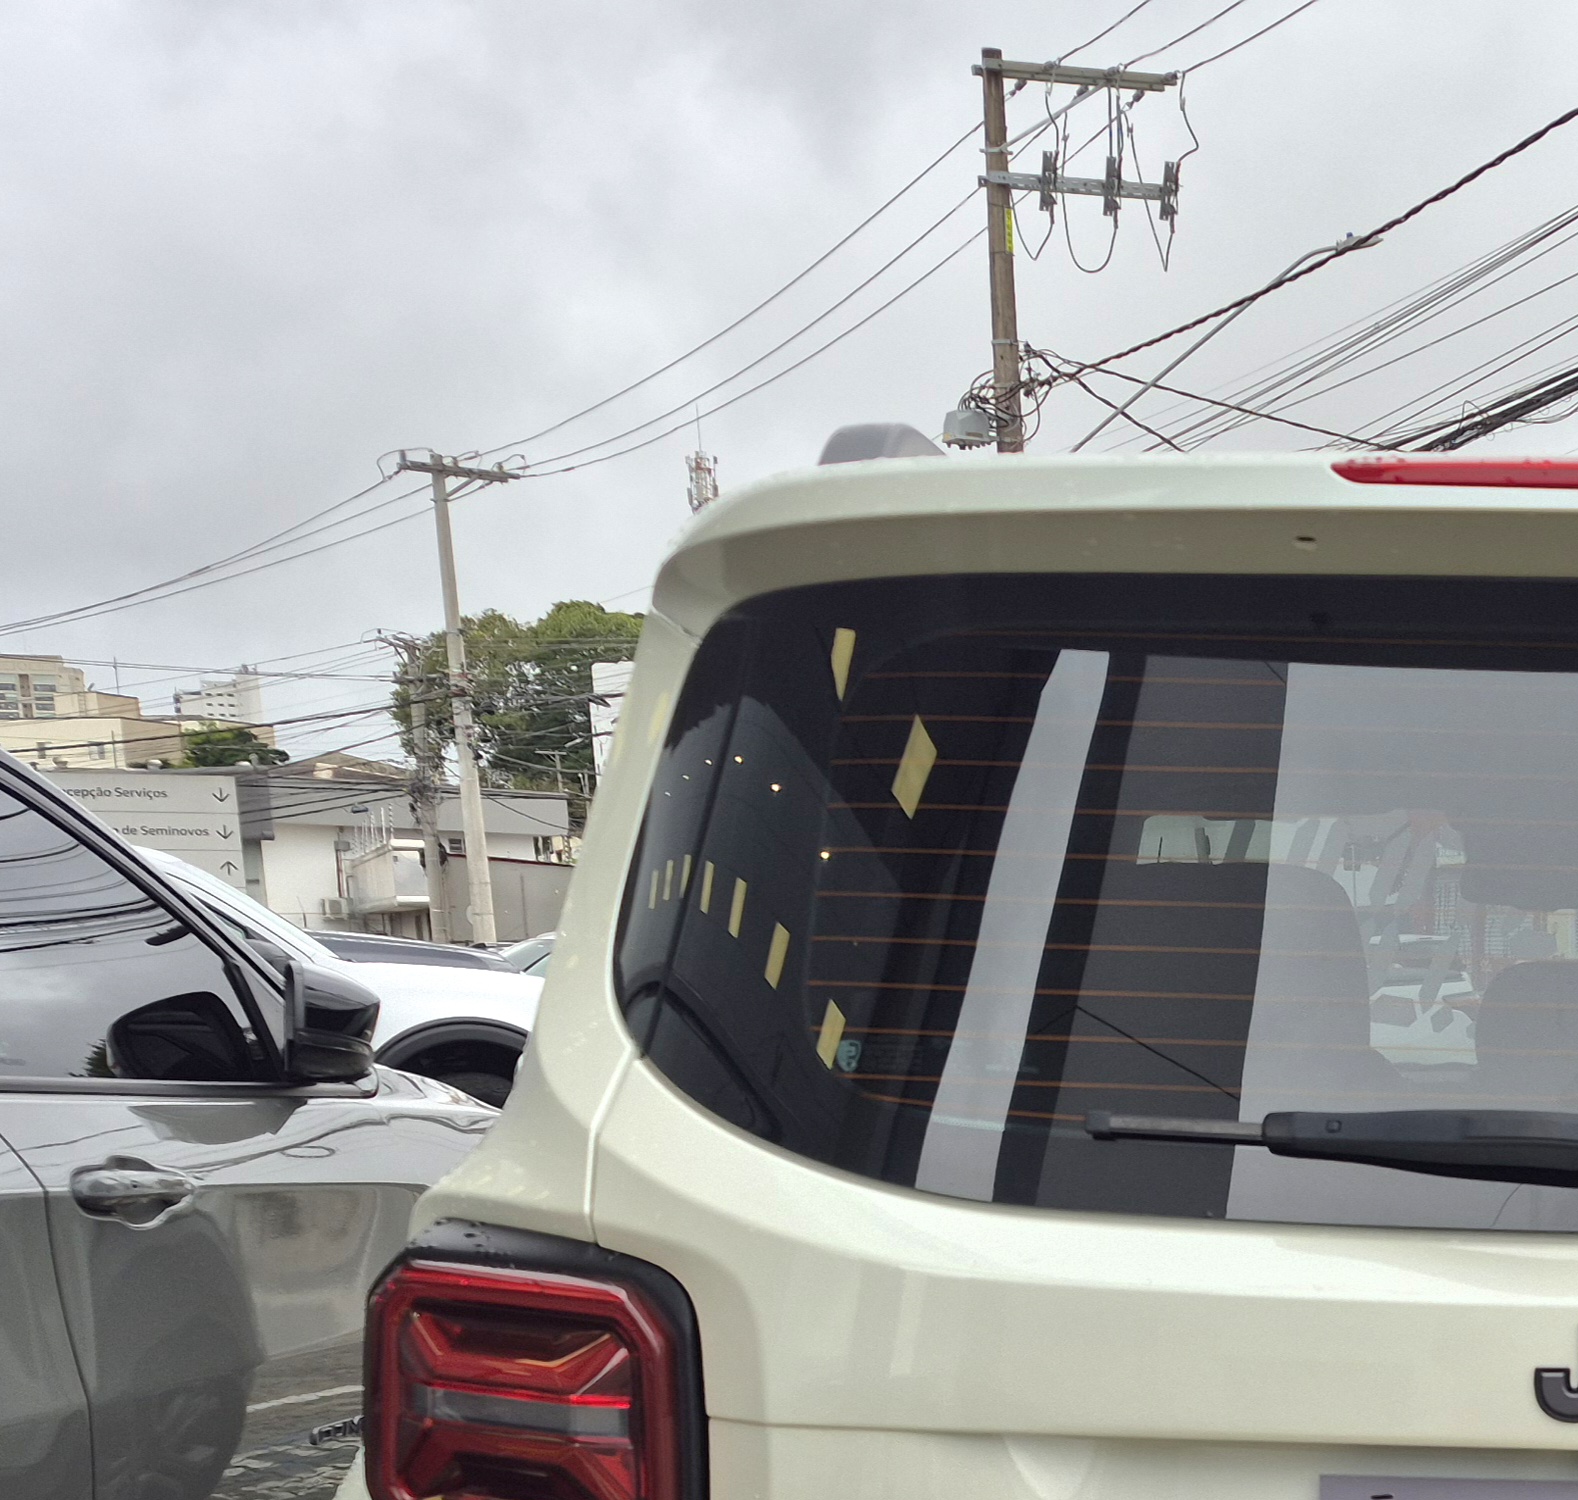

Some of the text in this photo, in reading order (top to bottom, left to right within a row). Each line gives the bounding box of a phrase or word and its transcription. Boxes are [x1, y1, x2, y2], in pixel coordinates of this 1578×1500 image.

[114, 786, 168, 800] Serviços
[121, 825, 137, 835] de
[140, 825, 209, 836] Seminovos
